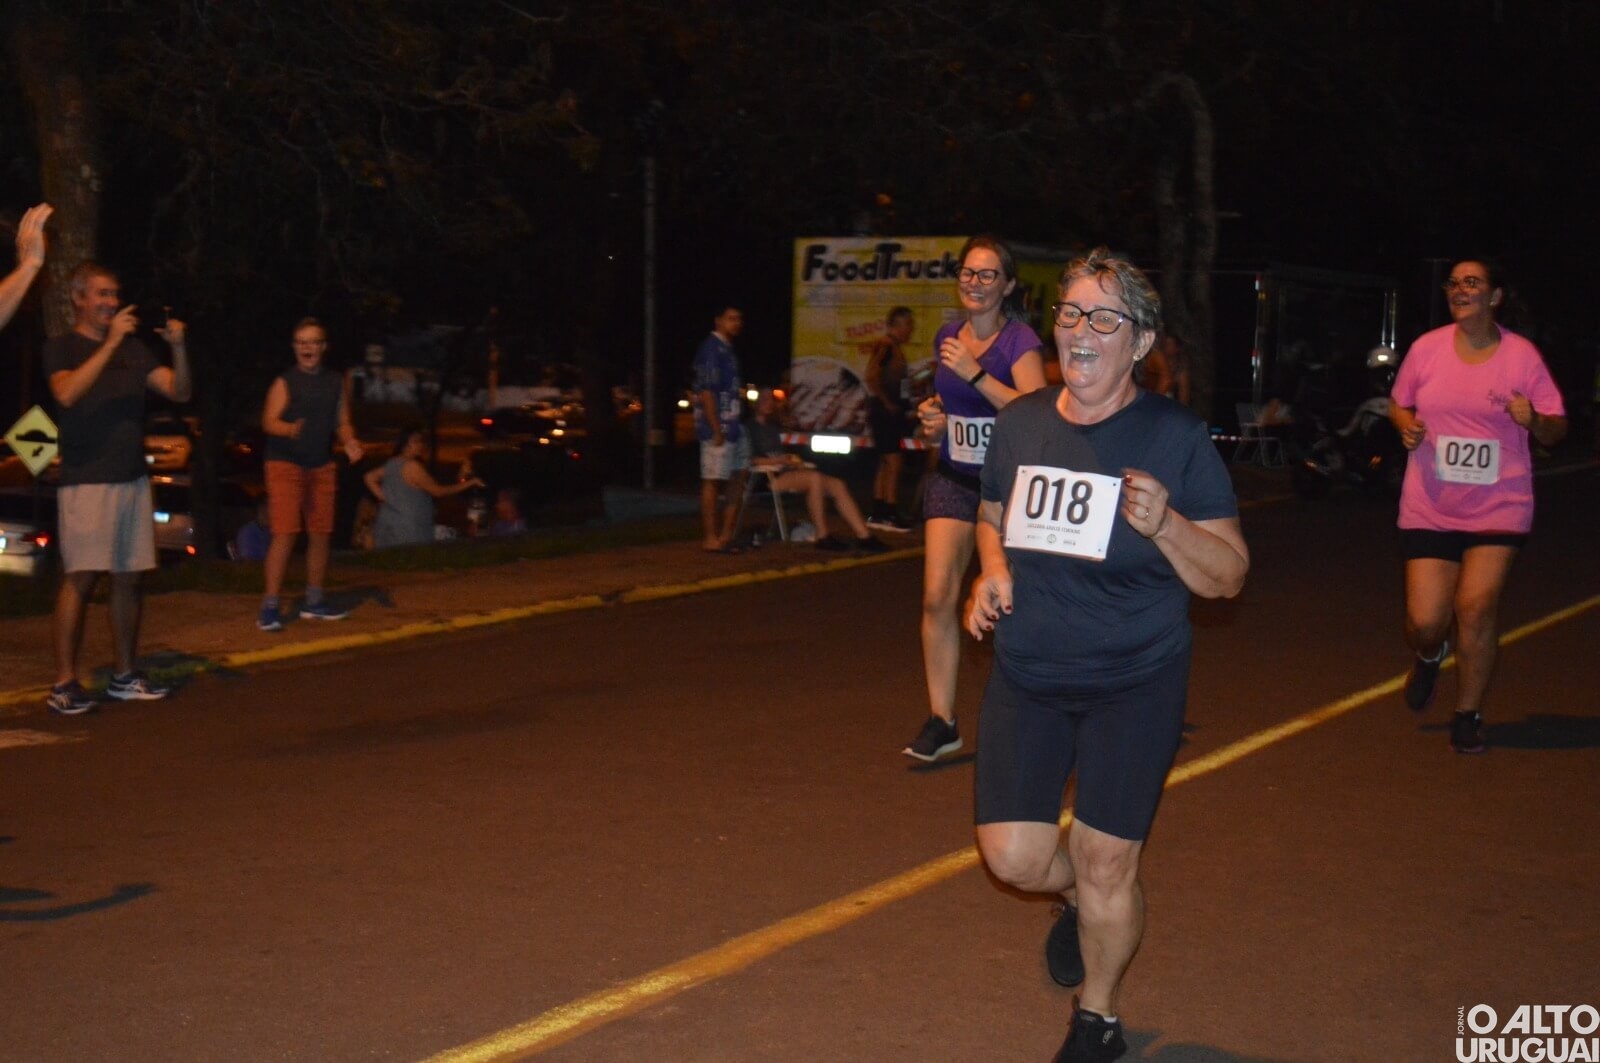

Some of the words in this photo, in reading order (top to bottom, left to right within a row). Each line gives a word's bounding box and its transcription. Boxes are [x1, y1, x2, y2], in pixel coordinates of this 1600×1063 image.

[954, 421, 992, 447] 009
[1446, 442, 1490, 468] 020
[1025, 474, 1093, 524] 018
